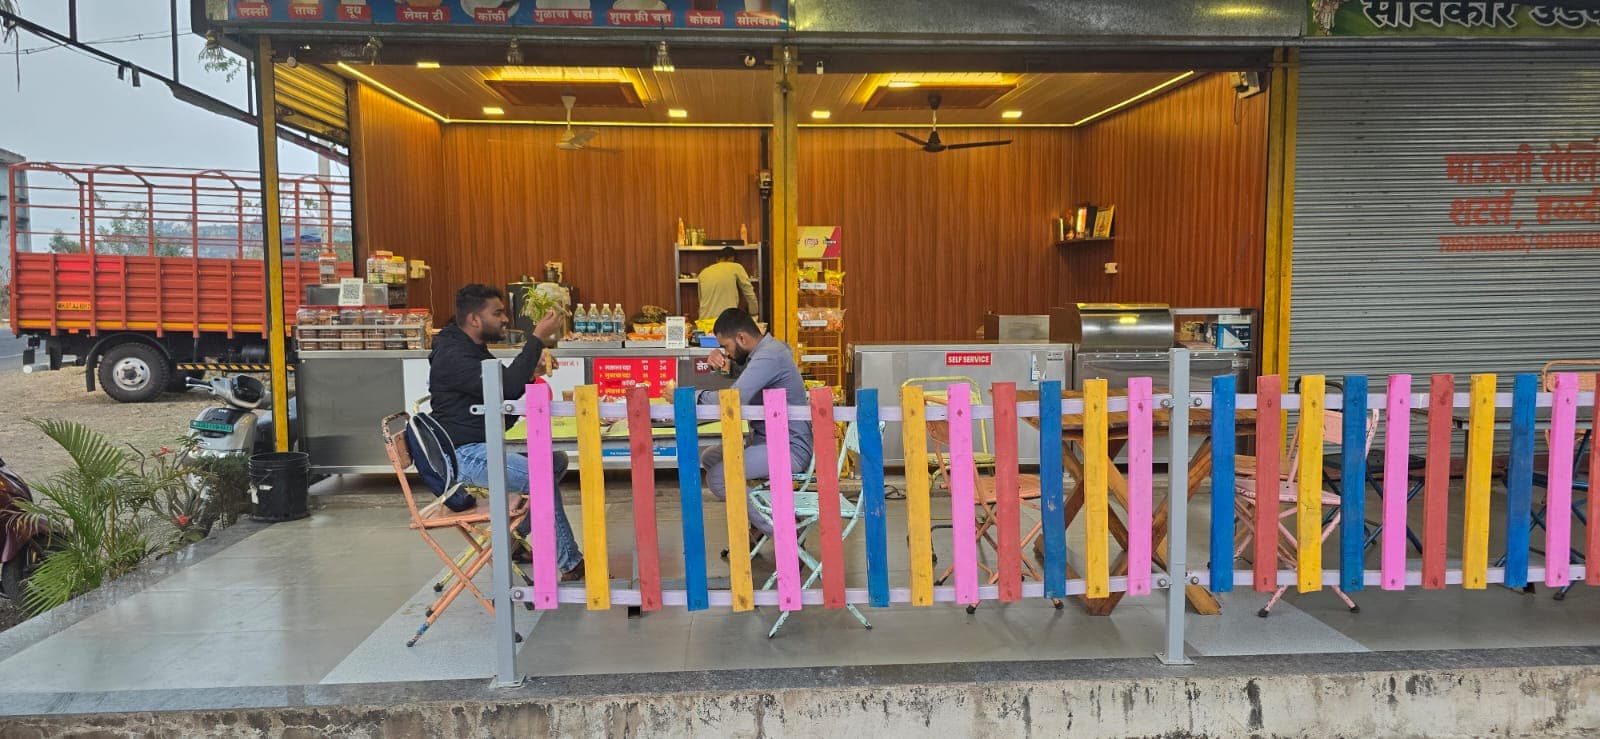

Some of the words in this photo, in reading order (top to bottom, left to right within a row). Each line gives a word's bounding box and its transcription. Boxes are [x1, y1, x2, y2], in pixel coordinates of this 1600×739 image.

[239, 5, 269, 17] लस्सी
[294, 6, 318, 16] ताक
[346, 6, 362, 19] दूध
[403, 8, 429, 20] लेमन
[432, 9, 444, 21] टी
[477, 9, 506, 21] कॉफी
[534, 9, 569, 22] गुळाचा
[571, 9, 593, 20] चहा
[609, 11, 632, 24] शुगर
[634, 10, 649, 22] फ्री
[650, 12, 672, 24] चहा
[688, 12, 721, 25] कोकम
[1445, 143, 1534, 184] माऊली
[948, 355, 962, 363] SELF
[963, 355, 990, 363] SERVICE
